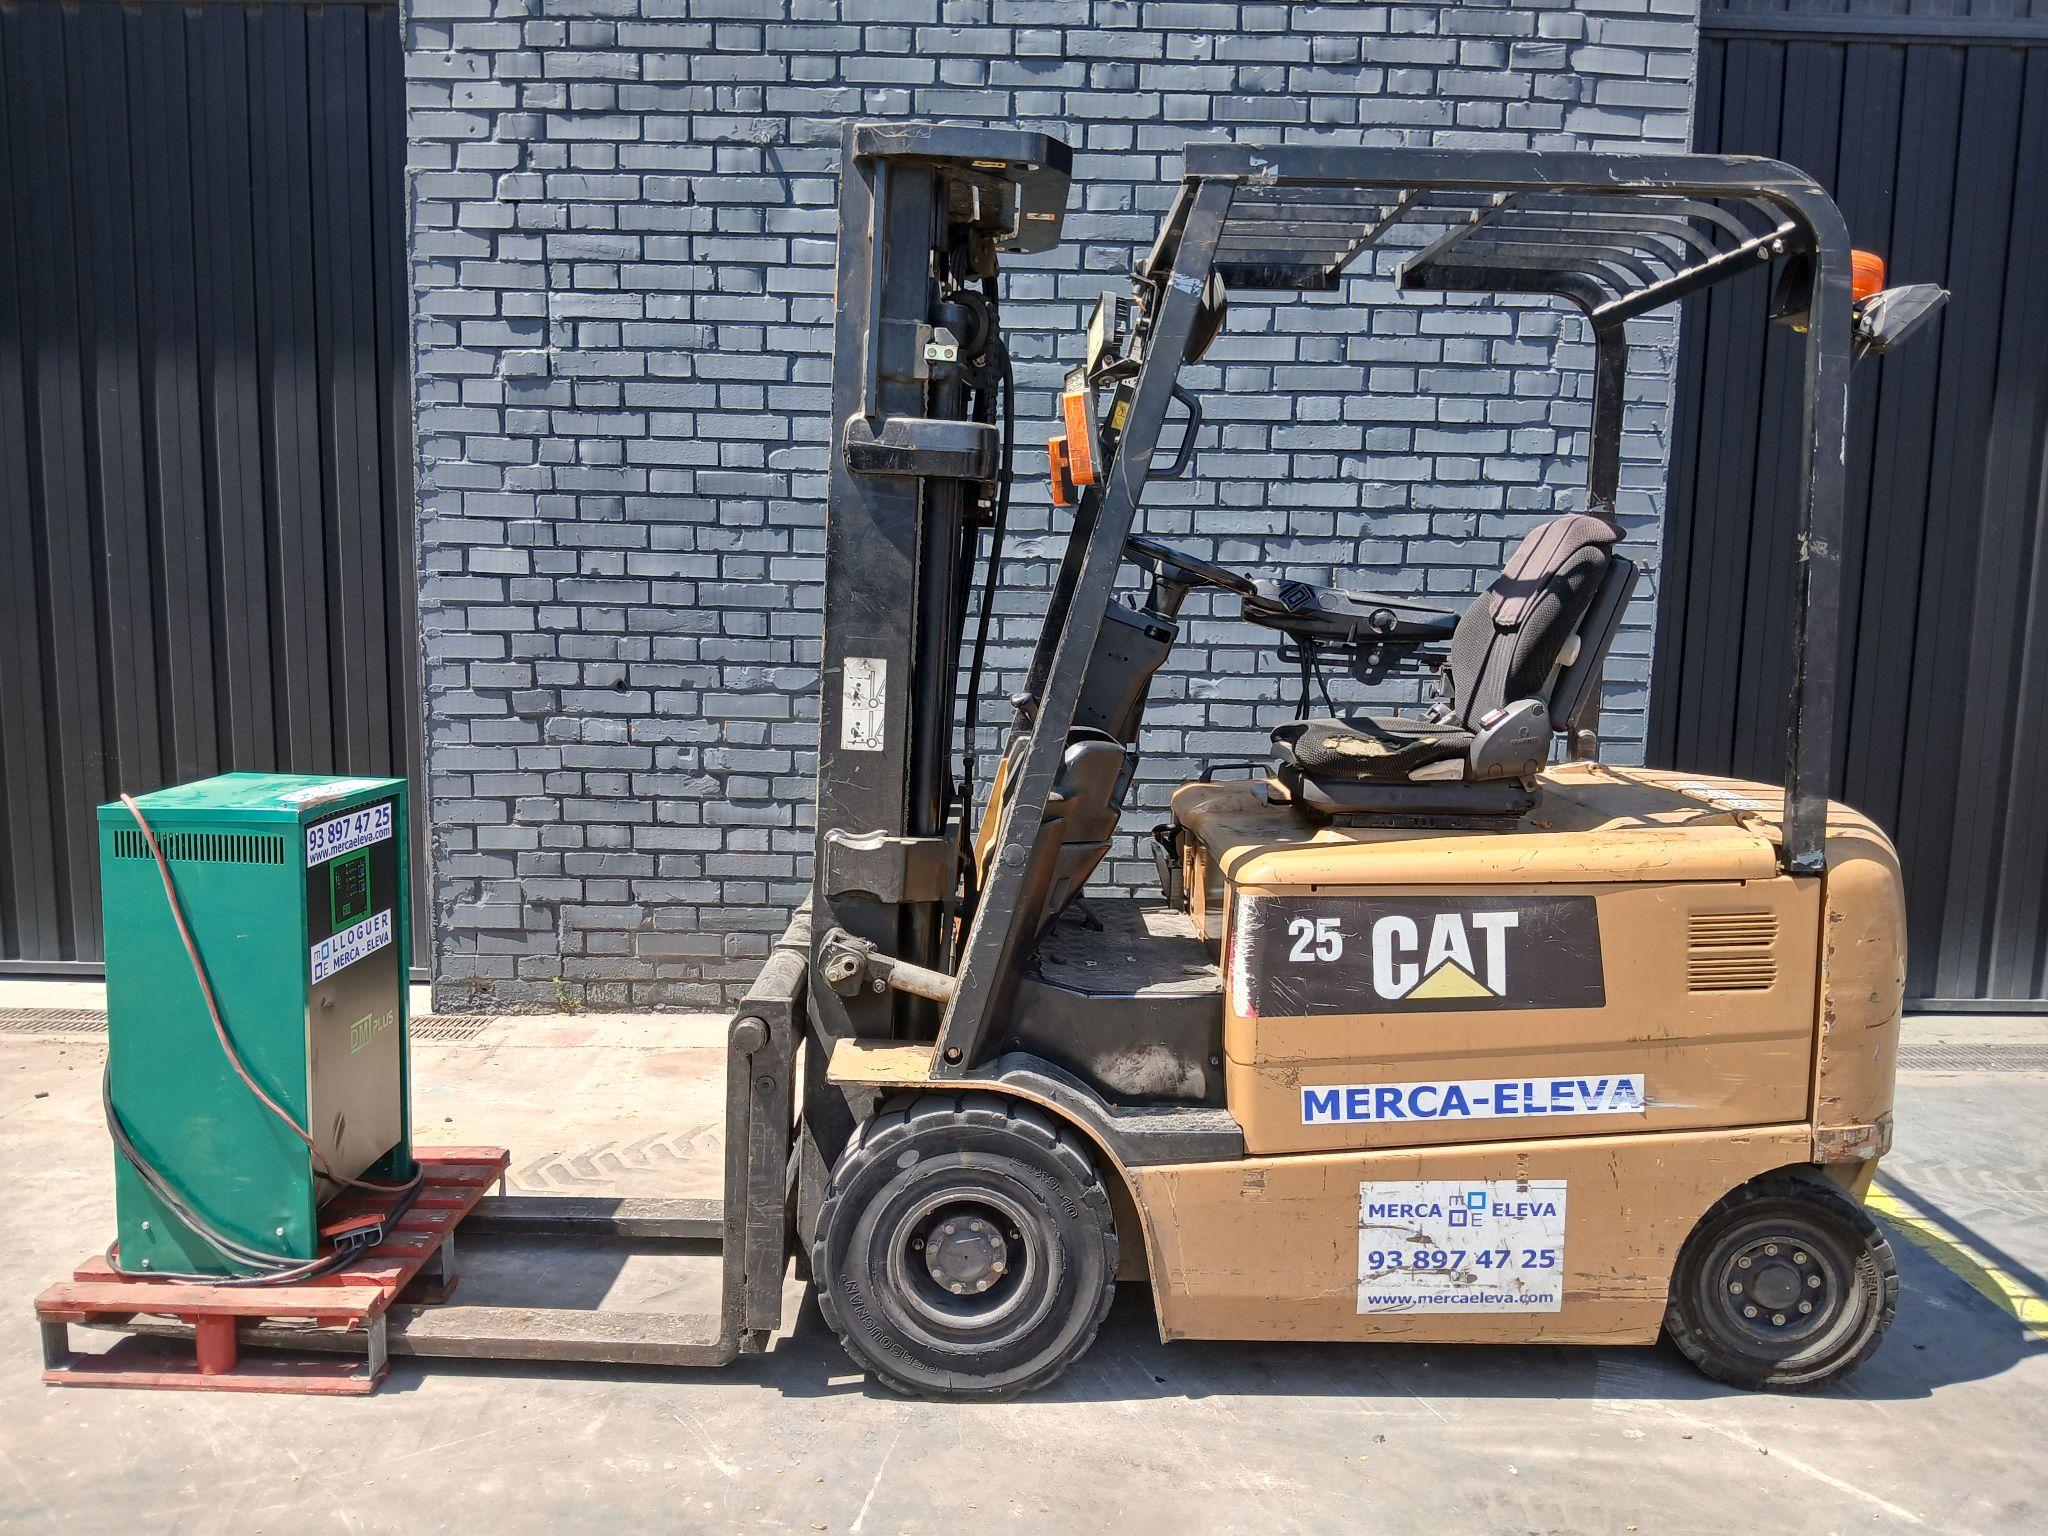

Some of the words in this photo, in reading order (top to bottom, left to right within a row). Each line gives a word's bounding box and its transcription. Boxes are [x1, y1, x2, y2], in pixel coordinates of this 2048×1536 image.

[309, 827, 324, 852] 93
[328, 818, 351, 844] 897
[354, 812, 370, 834] 47
[374, 807, 390, 828] 25
[310, 827, 390, 864] www.mercaeleva.com
[332, 913, 389, 954] LLOGUER
[333, 948, 360, 971] MERCA
[366, 931, 389, 952] ELEVA
[1288, 917, 1343, 962] 25
[1372, 911, 1519, 1000] CAT
[373, 1009, 394, 1035] PLUS
[1303, 1078, 1641, 1122] MERCA-ELEVA
[1368, 1203, 1443, 1218] MERCA
[1492, 1202, 1557, 1217] ELEVA
[1368, 1250, 1403, 1270] 93
[1412, 1249, 1467, 1270] 897
[1475, 1249, 1511, 1269] 47
[1521, 1249, 1556, 1269] 25
[1367, 1291, 1554, 1306] www.mercaeleva.com
